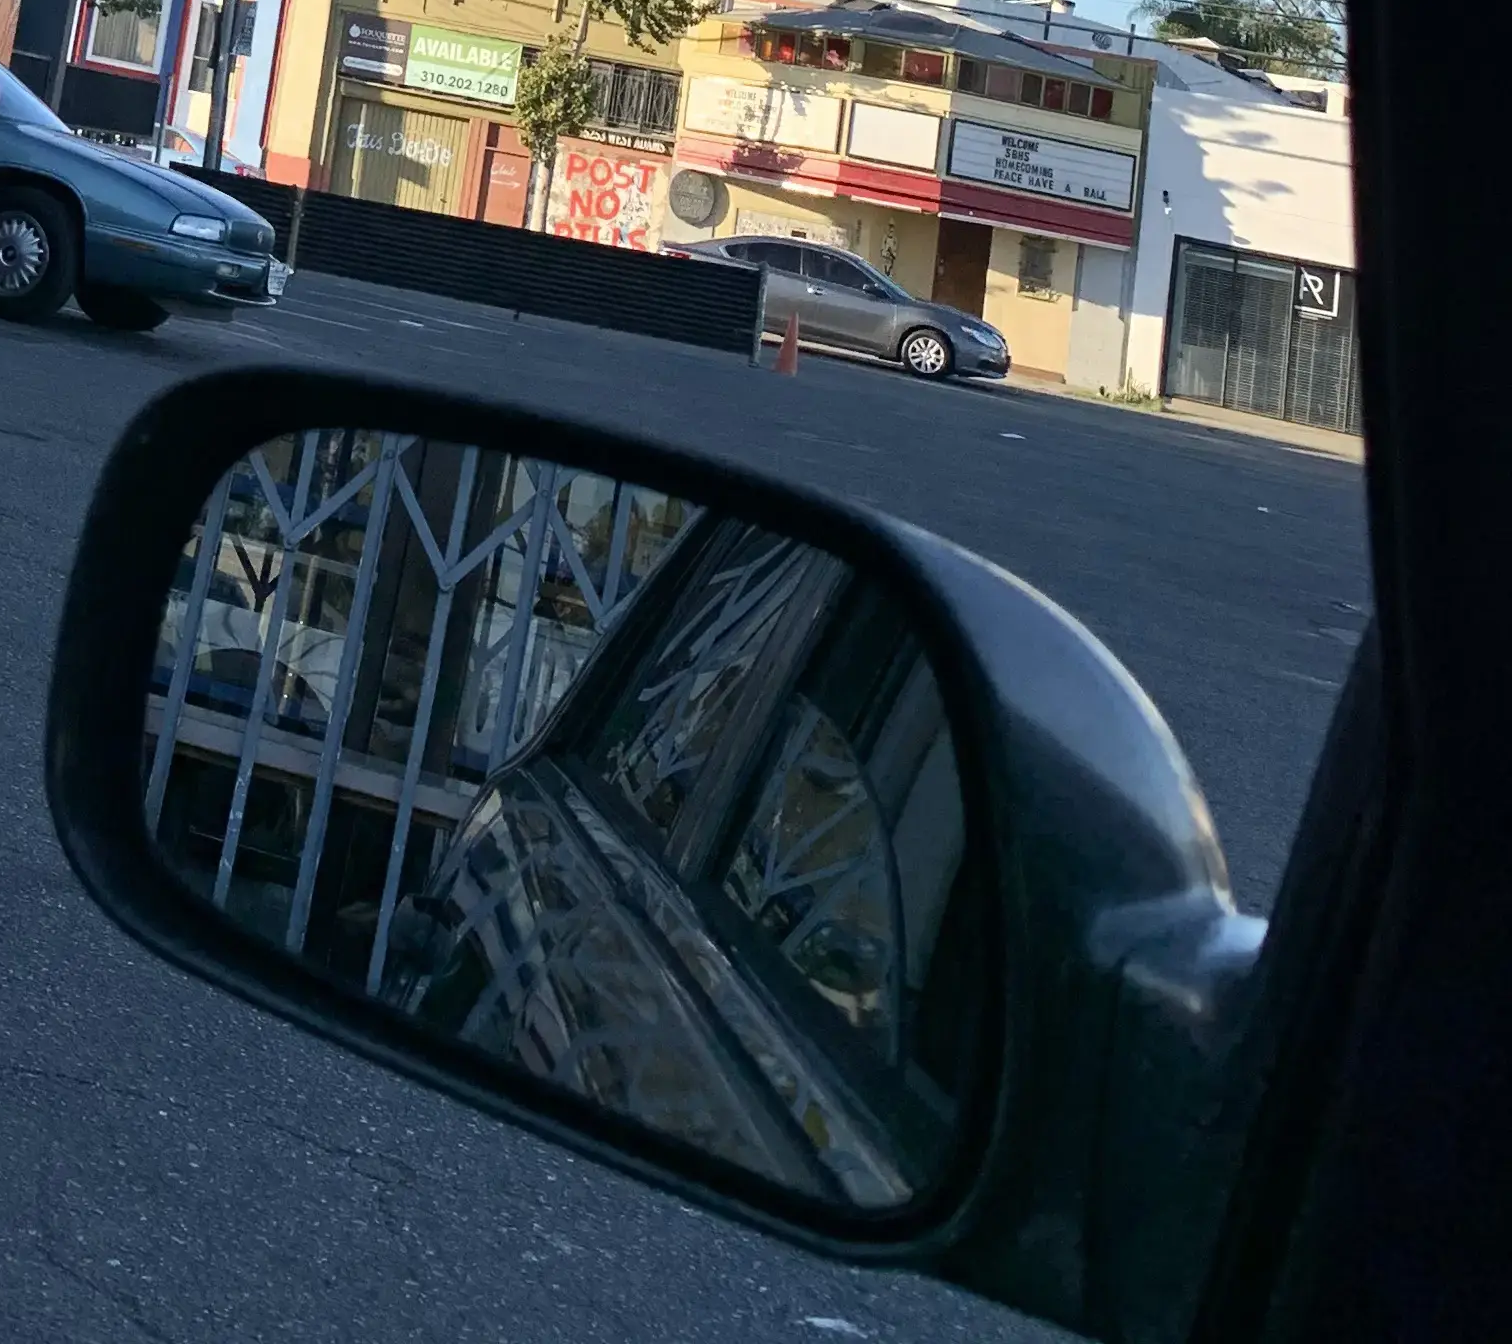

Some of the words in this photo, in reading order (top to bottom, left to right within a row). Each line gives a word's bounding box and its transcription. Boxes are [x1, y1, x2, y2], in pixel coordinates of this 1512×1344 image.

[413, 36, 513, 72] AVAILABLE
[420, 70, 509, 98] 310.202.1280
[1002, 135, 1039, 152] WELCOME
[1005, 148, 1030, 162] SBHS
[566, 153, 658, 193] POST
[995, 158, 1053, 178] HOMECOMING
[994, 169, 1022, 183] PEACE
[1028, 176, 1054, 190] HAVE
[1065, 183, 1071, 193] A
[1084, 187, 1106, 201] BALL
[569, 190, 621, 220] NO
